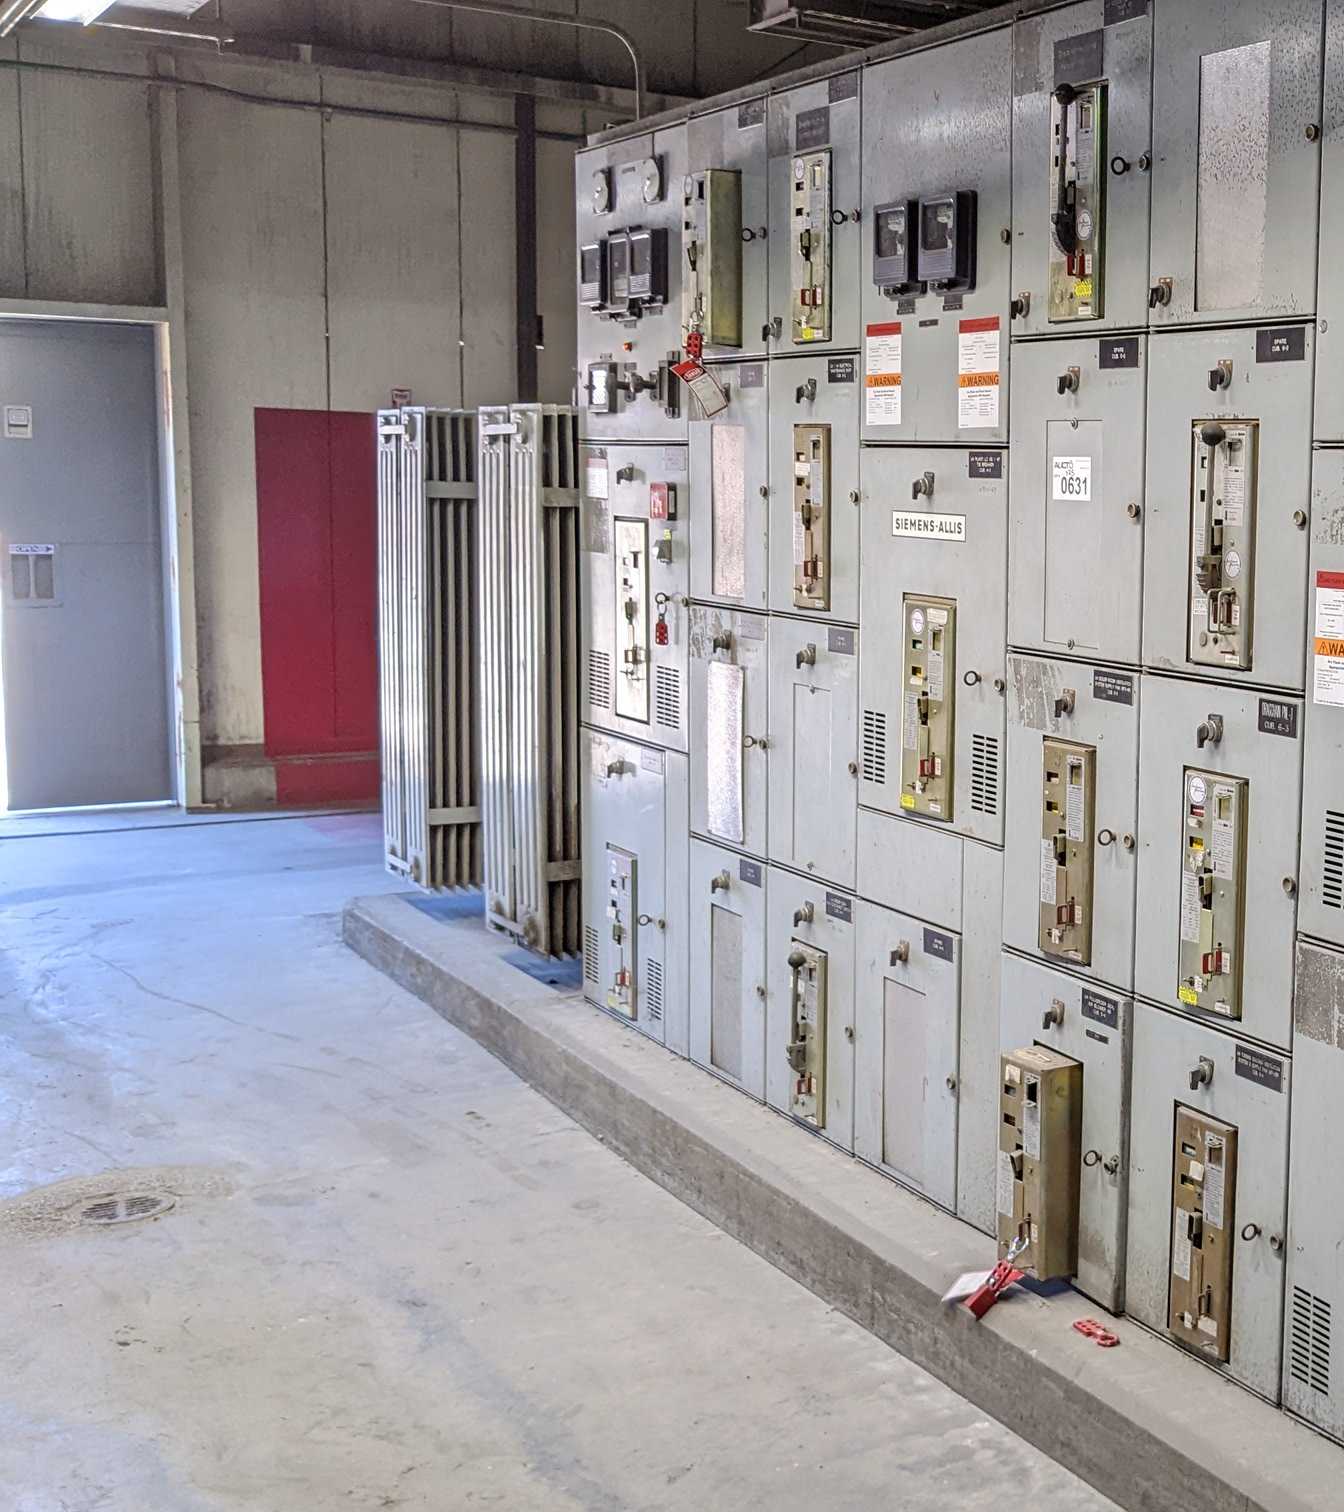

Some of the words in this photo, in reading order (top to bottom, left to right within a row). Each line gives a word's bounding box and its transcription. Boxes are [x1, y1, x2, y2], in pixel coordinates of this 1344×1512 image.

[873, 376, 901, 386] WARNING
[966, 375, 999, 386] WARNING
[1061, 476, 1087, 495] 0631
[895, 517, 962, 535] SIEMENS-ALLIS
